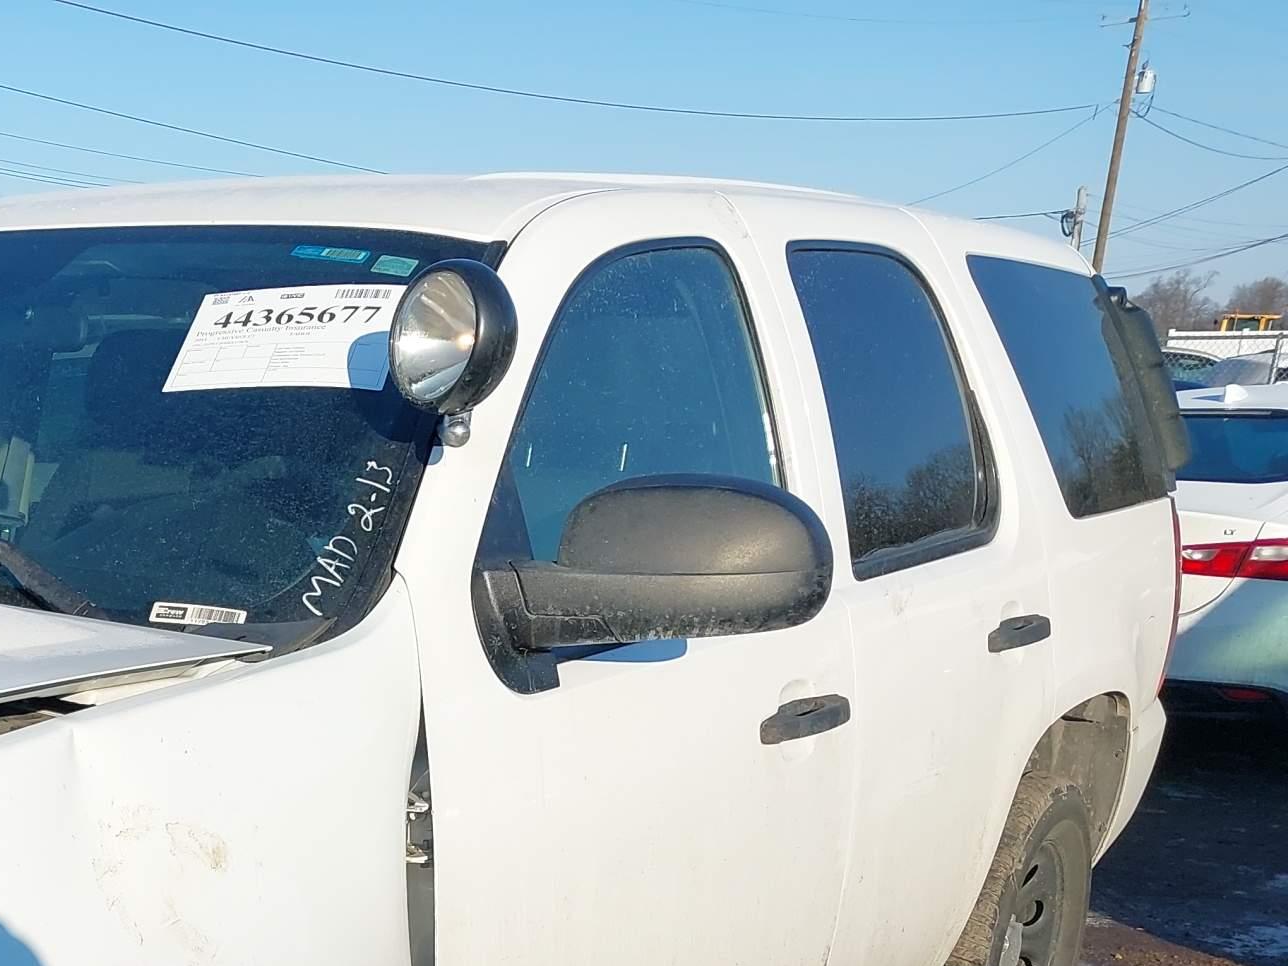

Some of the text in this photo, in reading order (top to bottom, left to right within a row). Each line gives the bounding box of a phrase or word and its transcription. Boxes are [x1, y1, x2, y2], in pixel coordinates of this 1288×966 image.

[213, 305, 382, 328] 44365677
[302, 460, 393, 616] MAD 2-13
